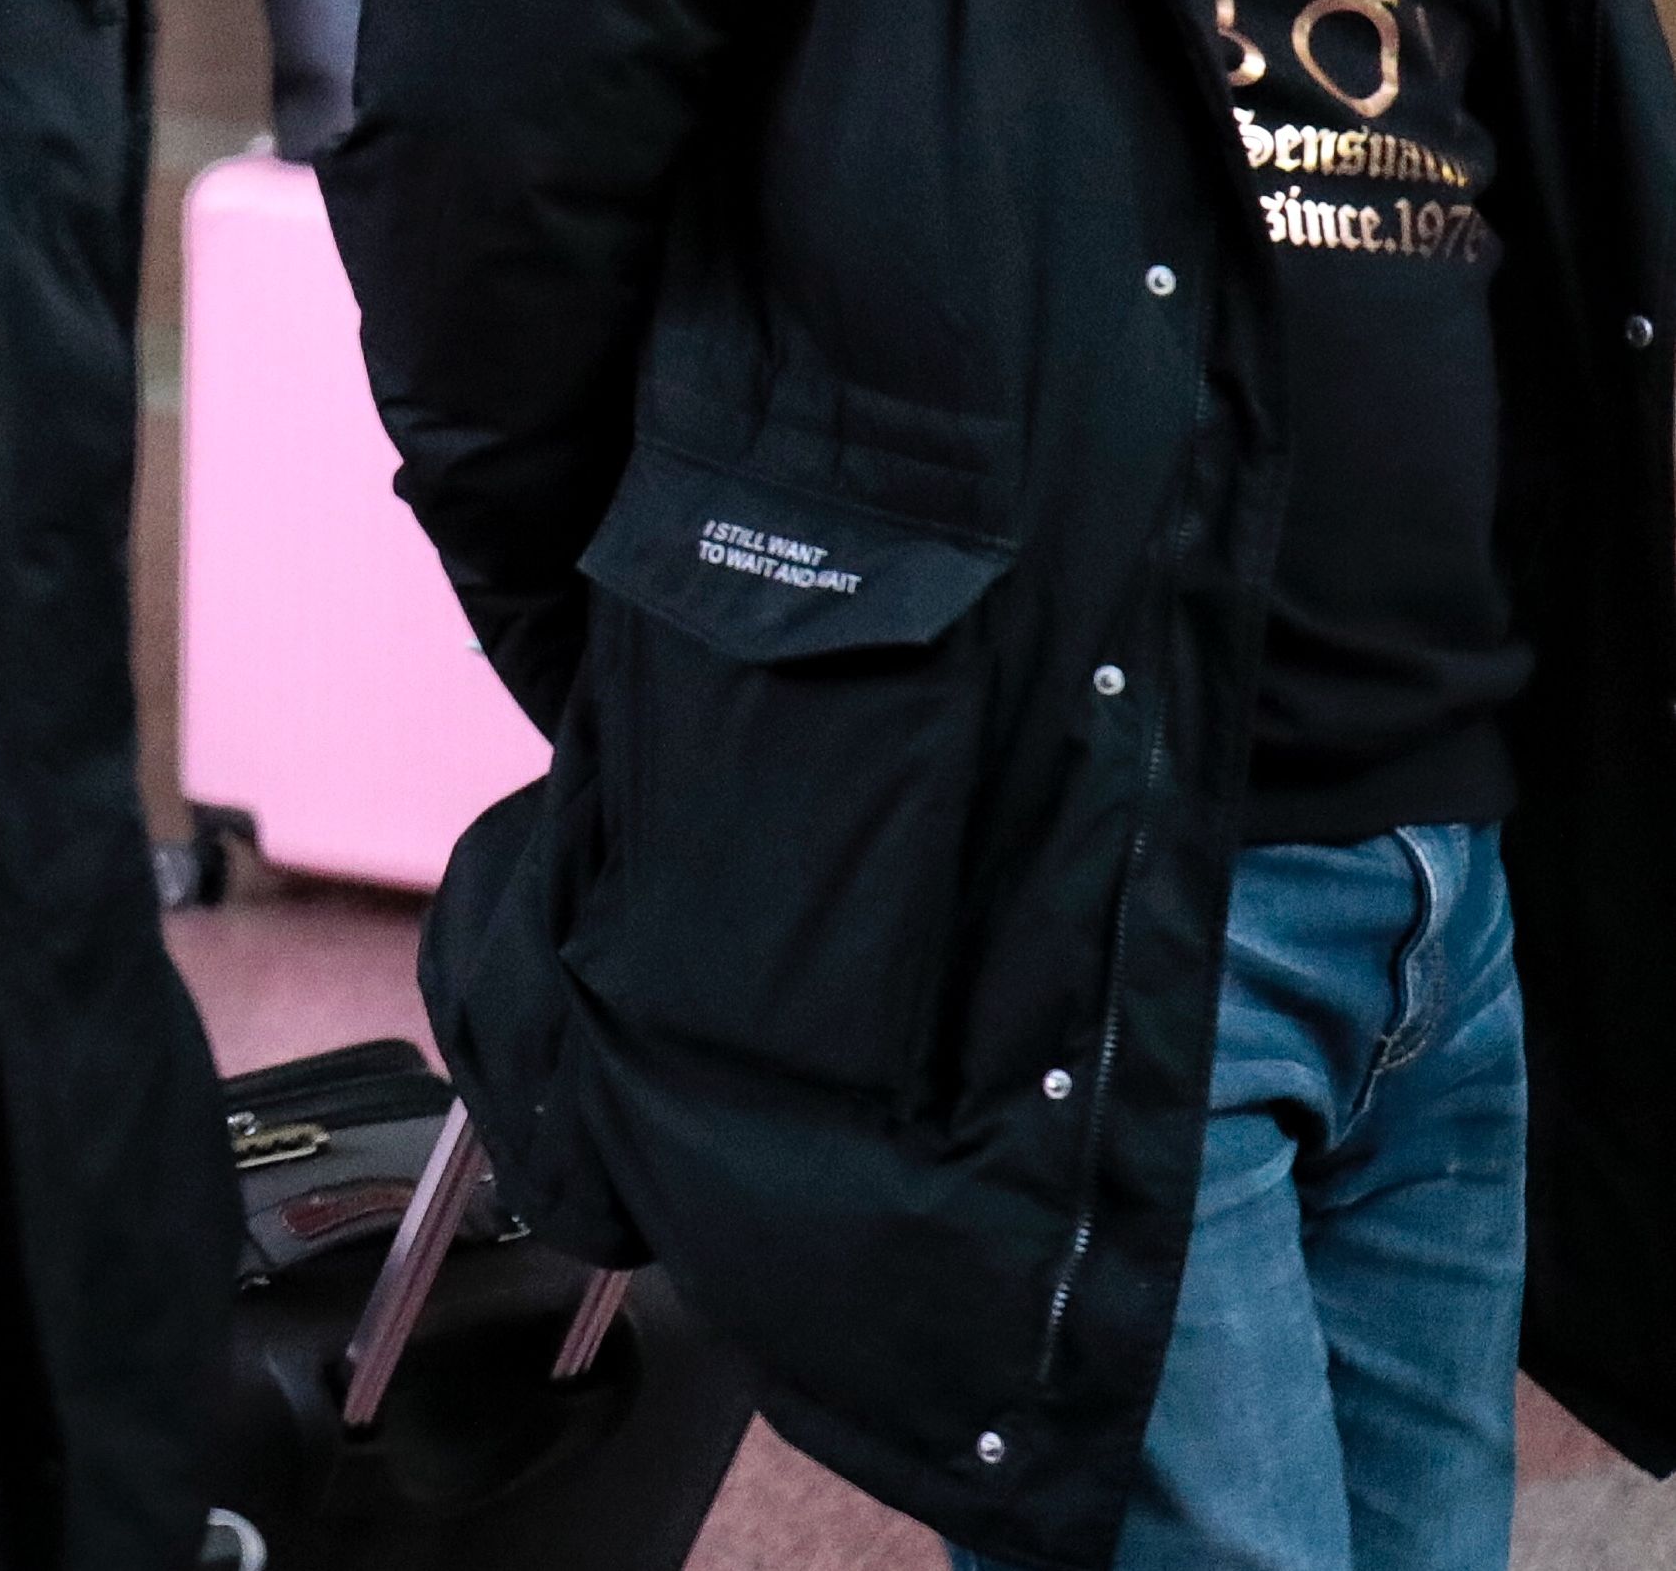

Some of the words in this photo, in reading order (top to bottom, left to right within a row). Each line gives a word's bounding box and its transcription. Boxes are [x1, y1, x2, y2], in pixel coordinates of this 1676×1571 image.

[699, 540, 725, 565] TO
[773, 563, 817, 589] AND
[703, 520, 716, 538] I
[714, 522, 765, 552] STILL
[767, 534, 828, 567] WANT
